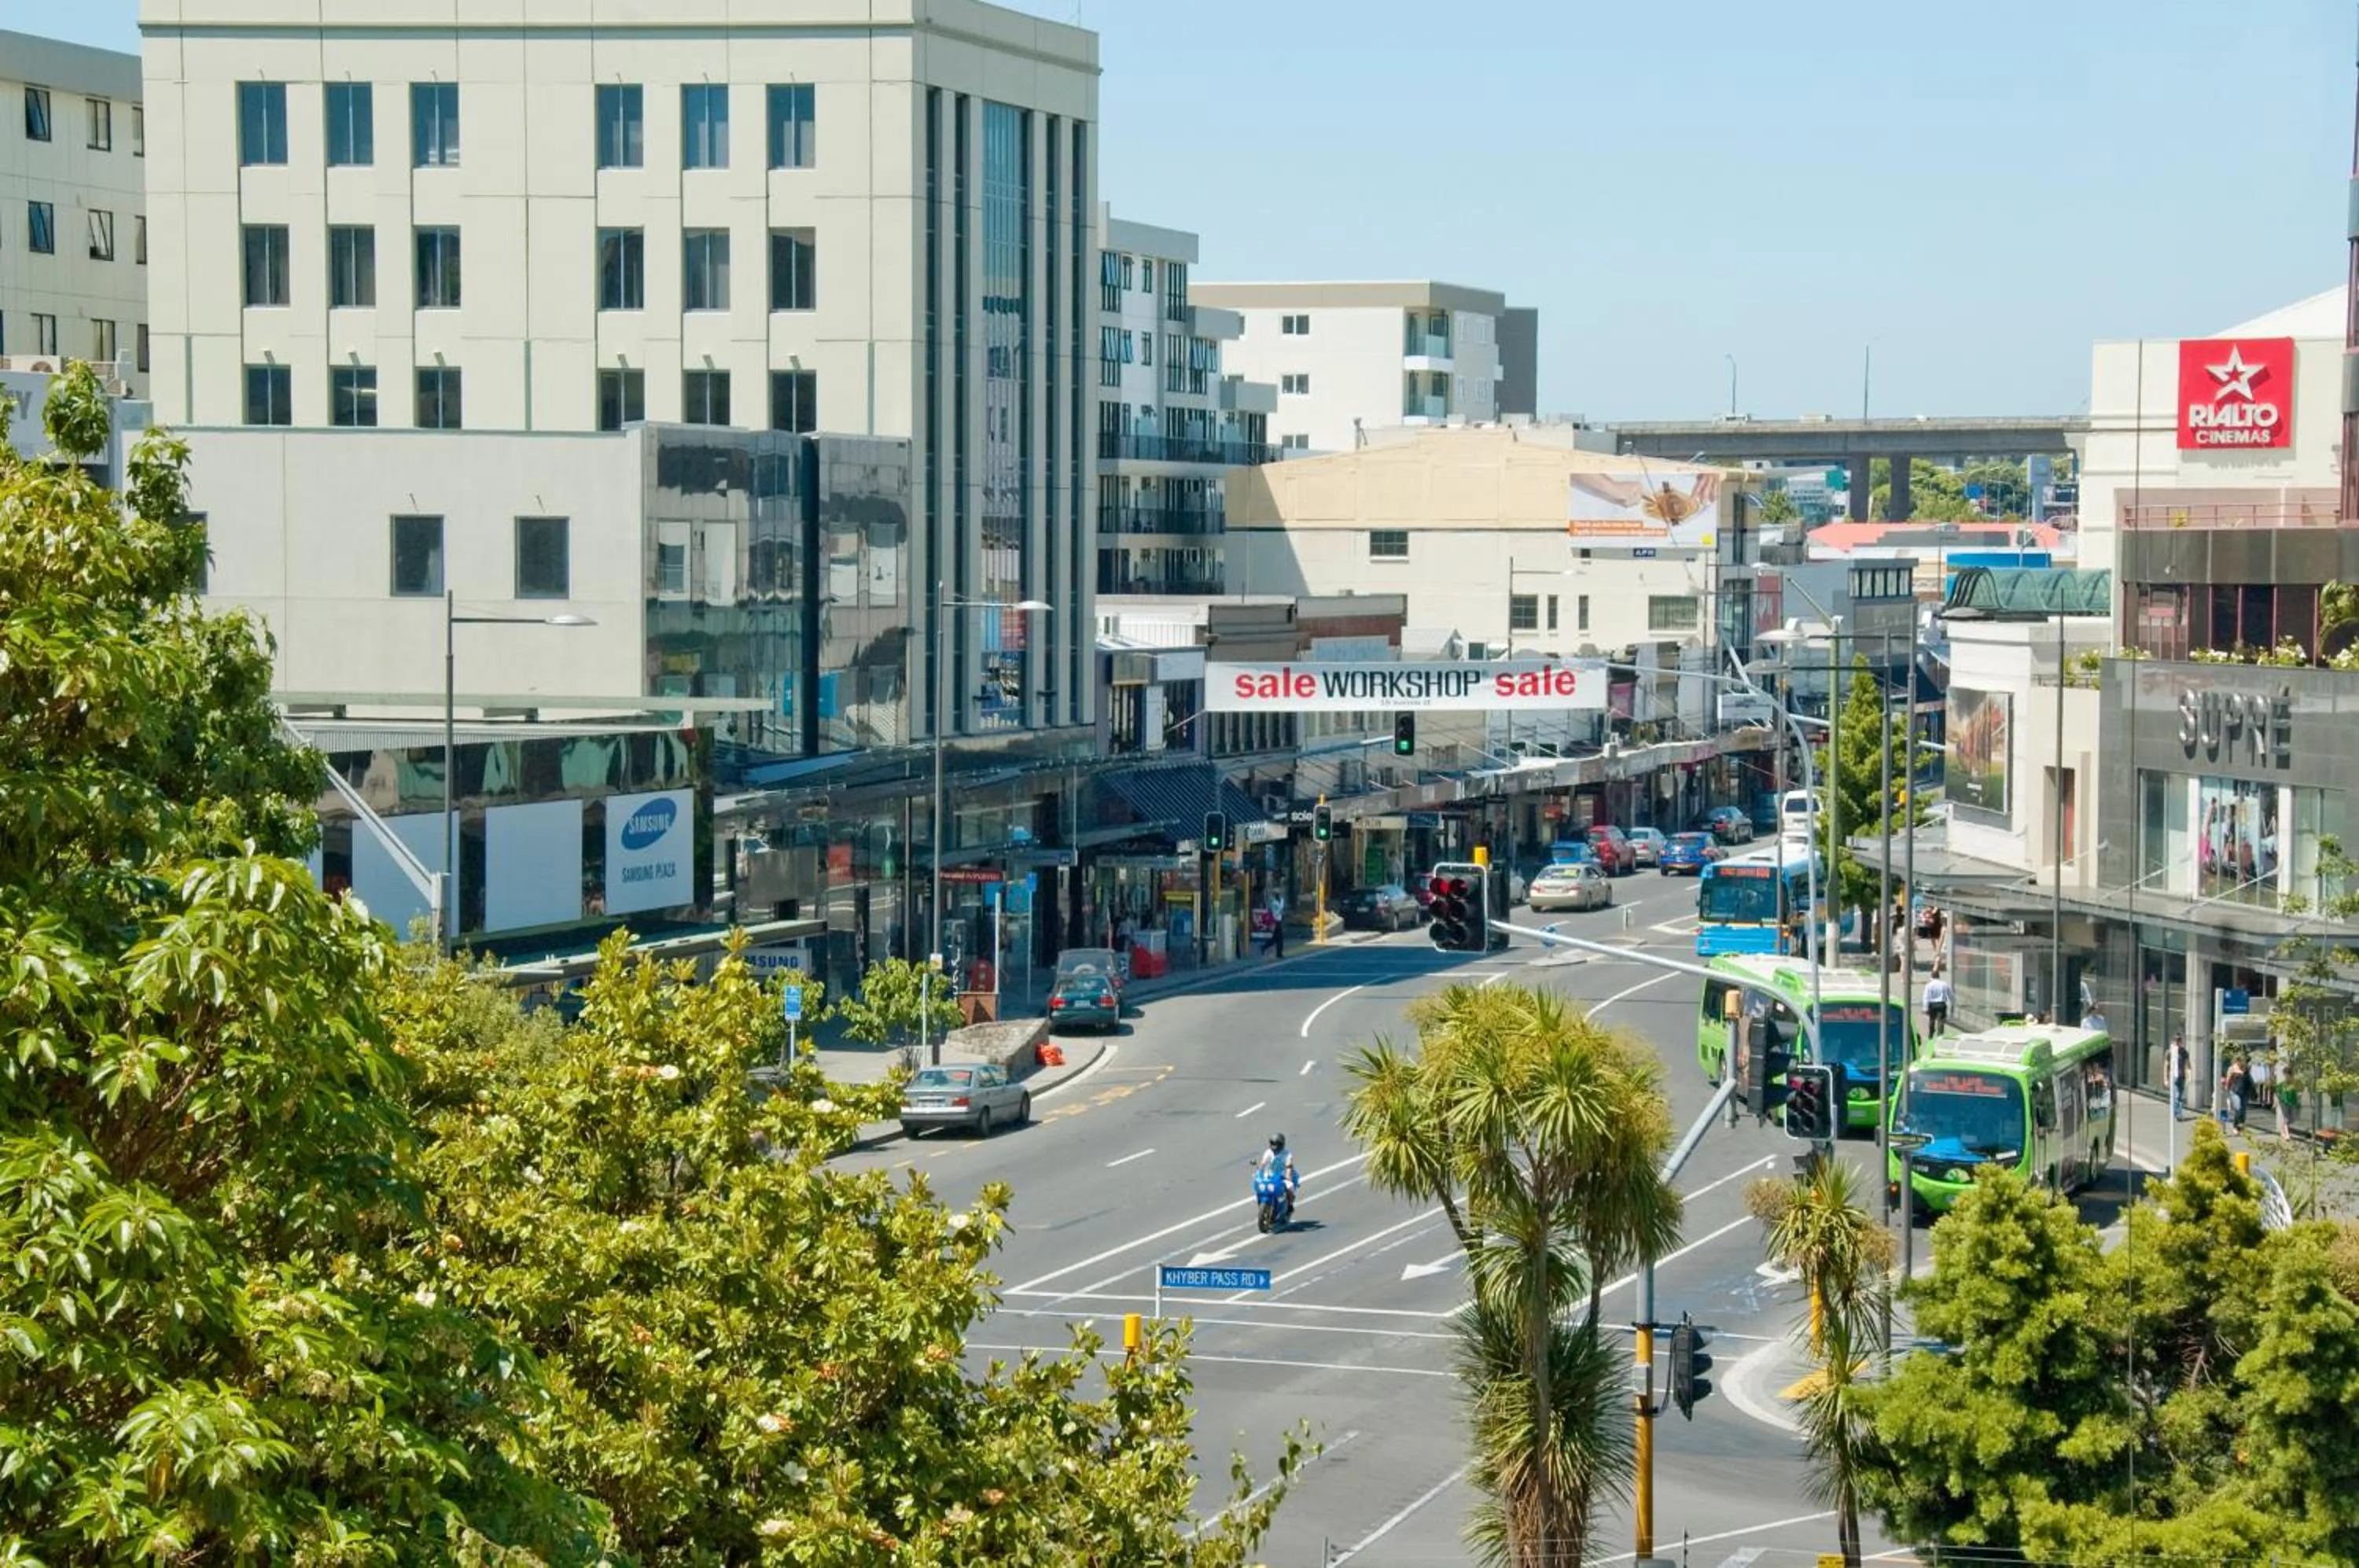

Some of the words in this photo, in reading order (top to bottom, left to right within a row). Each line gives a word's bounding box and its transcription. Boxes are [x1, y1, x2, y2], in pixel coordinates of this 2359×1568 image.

[2189, 402, 2278, 428] RIALTO
[2195, 429, 2271, 444] CINEMAS
[1235, 668, 1316, 699] sale
[1322, 670, 1481, 698] WORKSHOP
[1496, 665, 1577, 697] sale
[628, 813, 672, 834] SAMSUNG
[621, 864, 654, 883] SAMSUNG
[654, 861, 676, 879] PLAZA
[1165, 1270, 1209, 1284] KHYBER
[1210, 1272, 1238, 1286] PASS
[1241, 1272, 1257, 1286] RD
